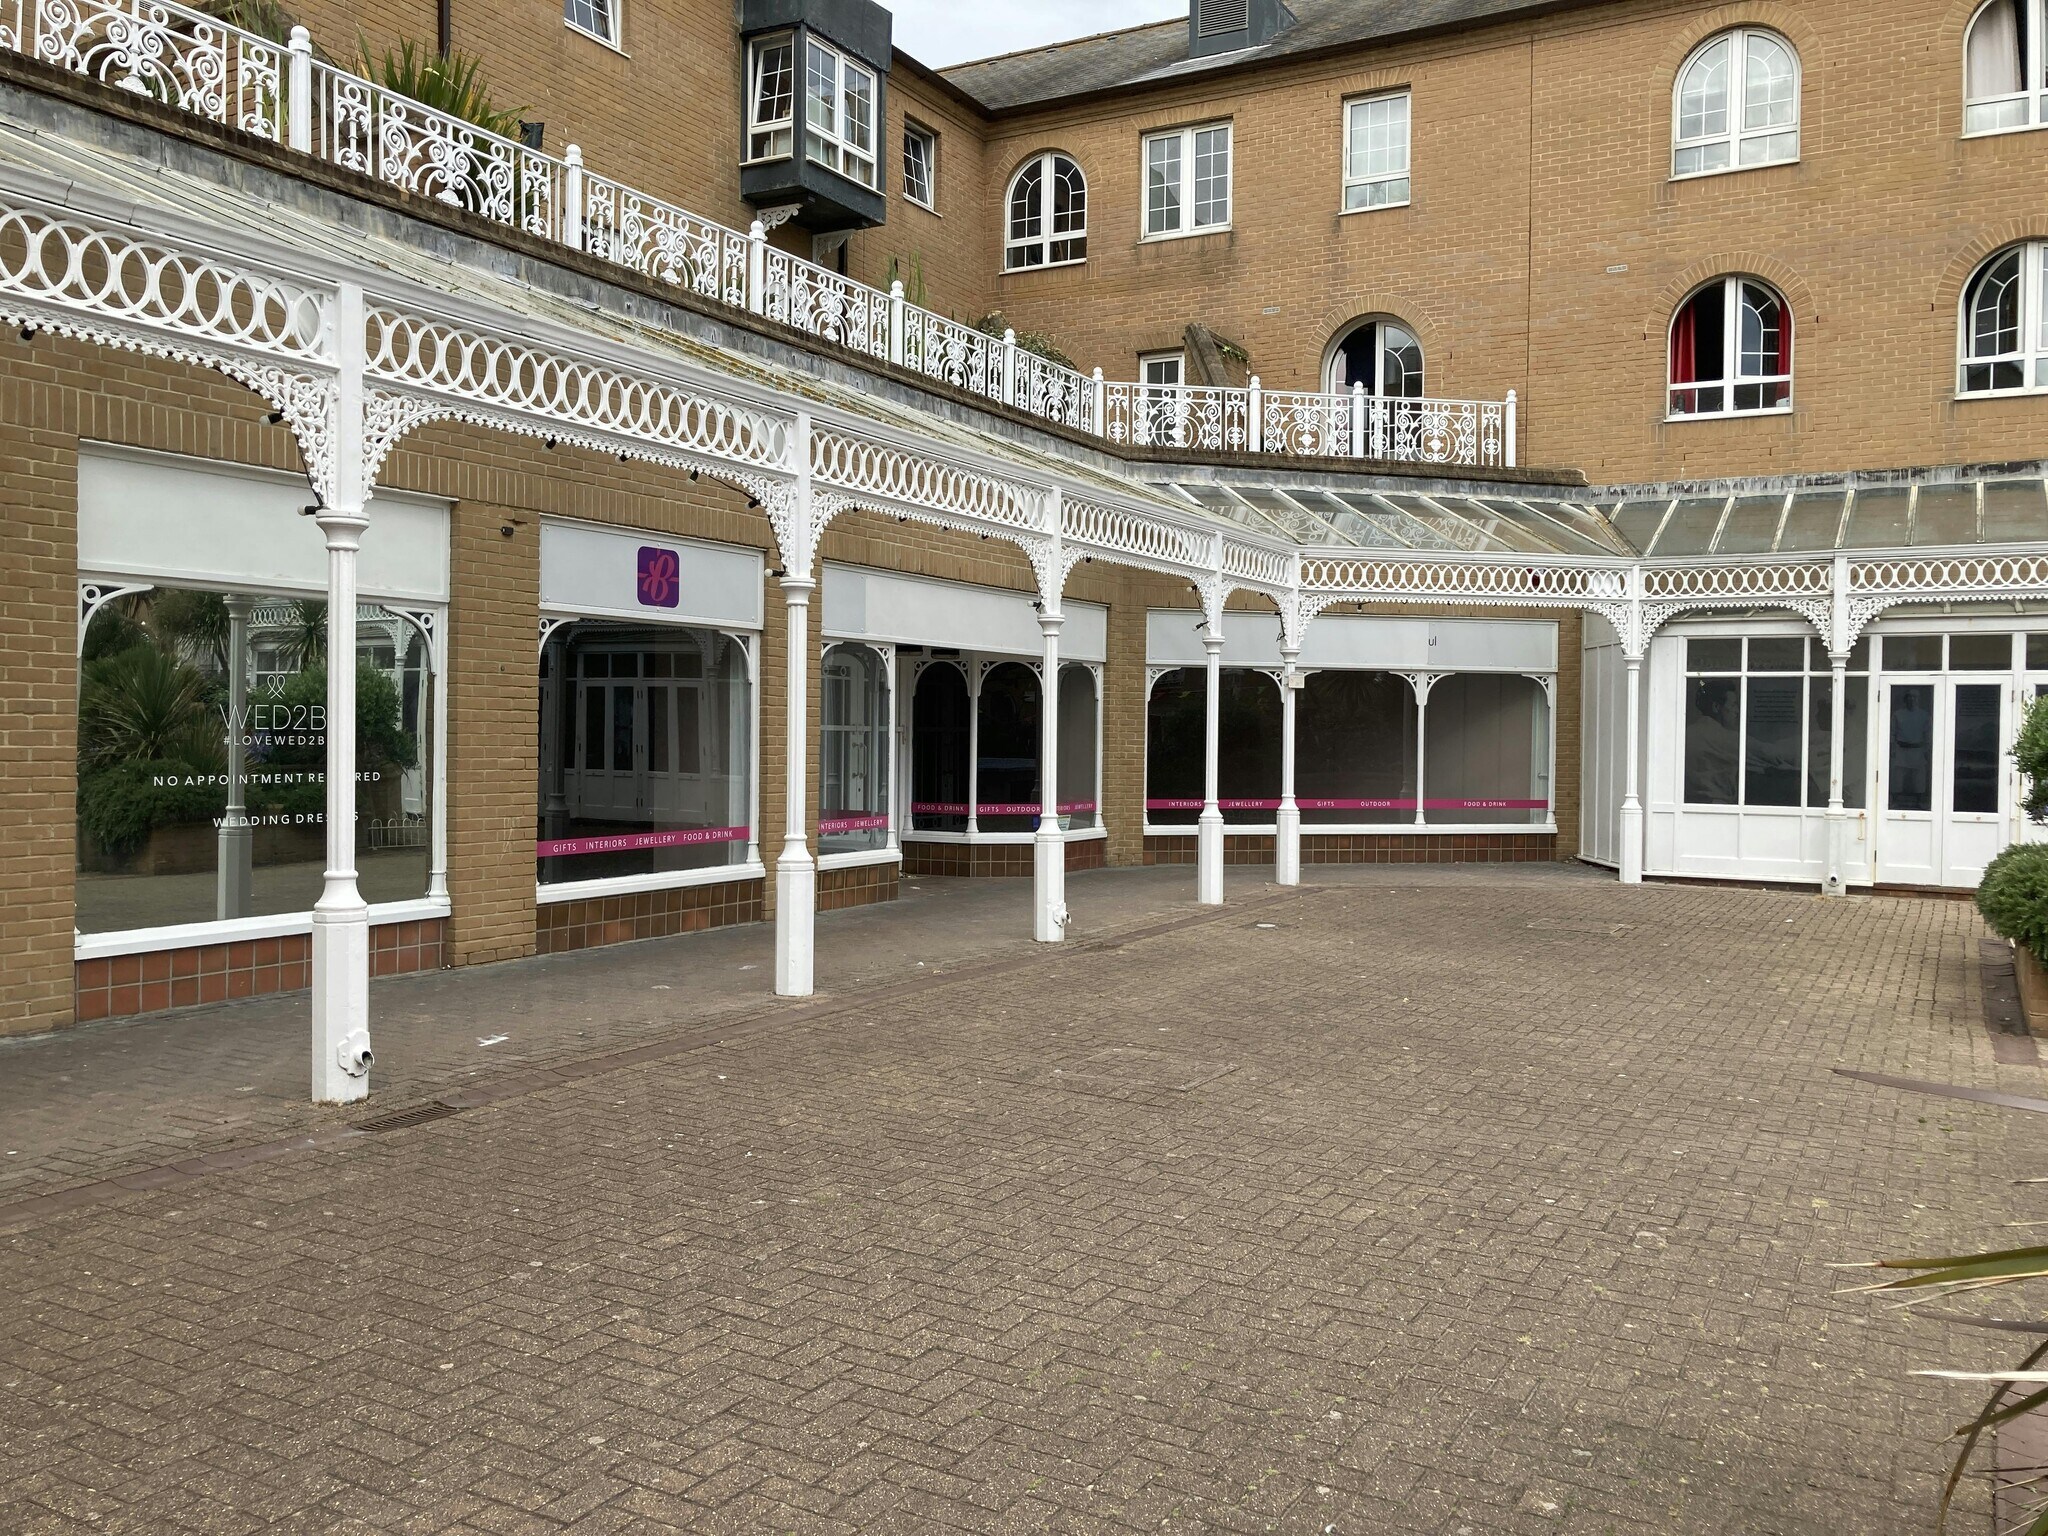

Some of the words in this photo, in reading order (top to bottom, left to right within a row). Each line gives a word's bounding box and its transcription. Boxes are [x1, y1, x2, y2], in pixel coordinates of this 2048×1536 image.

[1428, 635, 1437, 646] ul
[219, 704, 327, 730] WED2B
[223, 735, 325, 746] #LOVEWED2B
[153, 775, 178, 787] NO
[184, 773, 303, 786] APPOINTMENT
[308, 772, 381, 783] RERED
[213, 814, 290, 828] WEDDING
[295, 811, 359, 824] DRES
[818, 821, 848, 830] INTERIORS
[854, 819, 883, 828] JEWELLERY
[553, 843, 577, 853] GIFTS
[585, 839, 627, 850] INTERIORS
[635, 835, 676, 846] JEWELLERY
[683, 832, 703, 841] FOOD
[705, 832, 710, 840] &
[712, 830, 733, 839] DRINK
